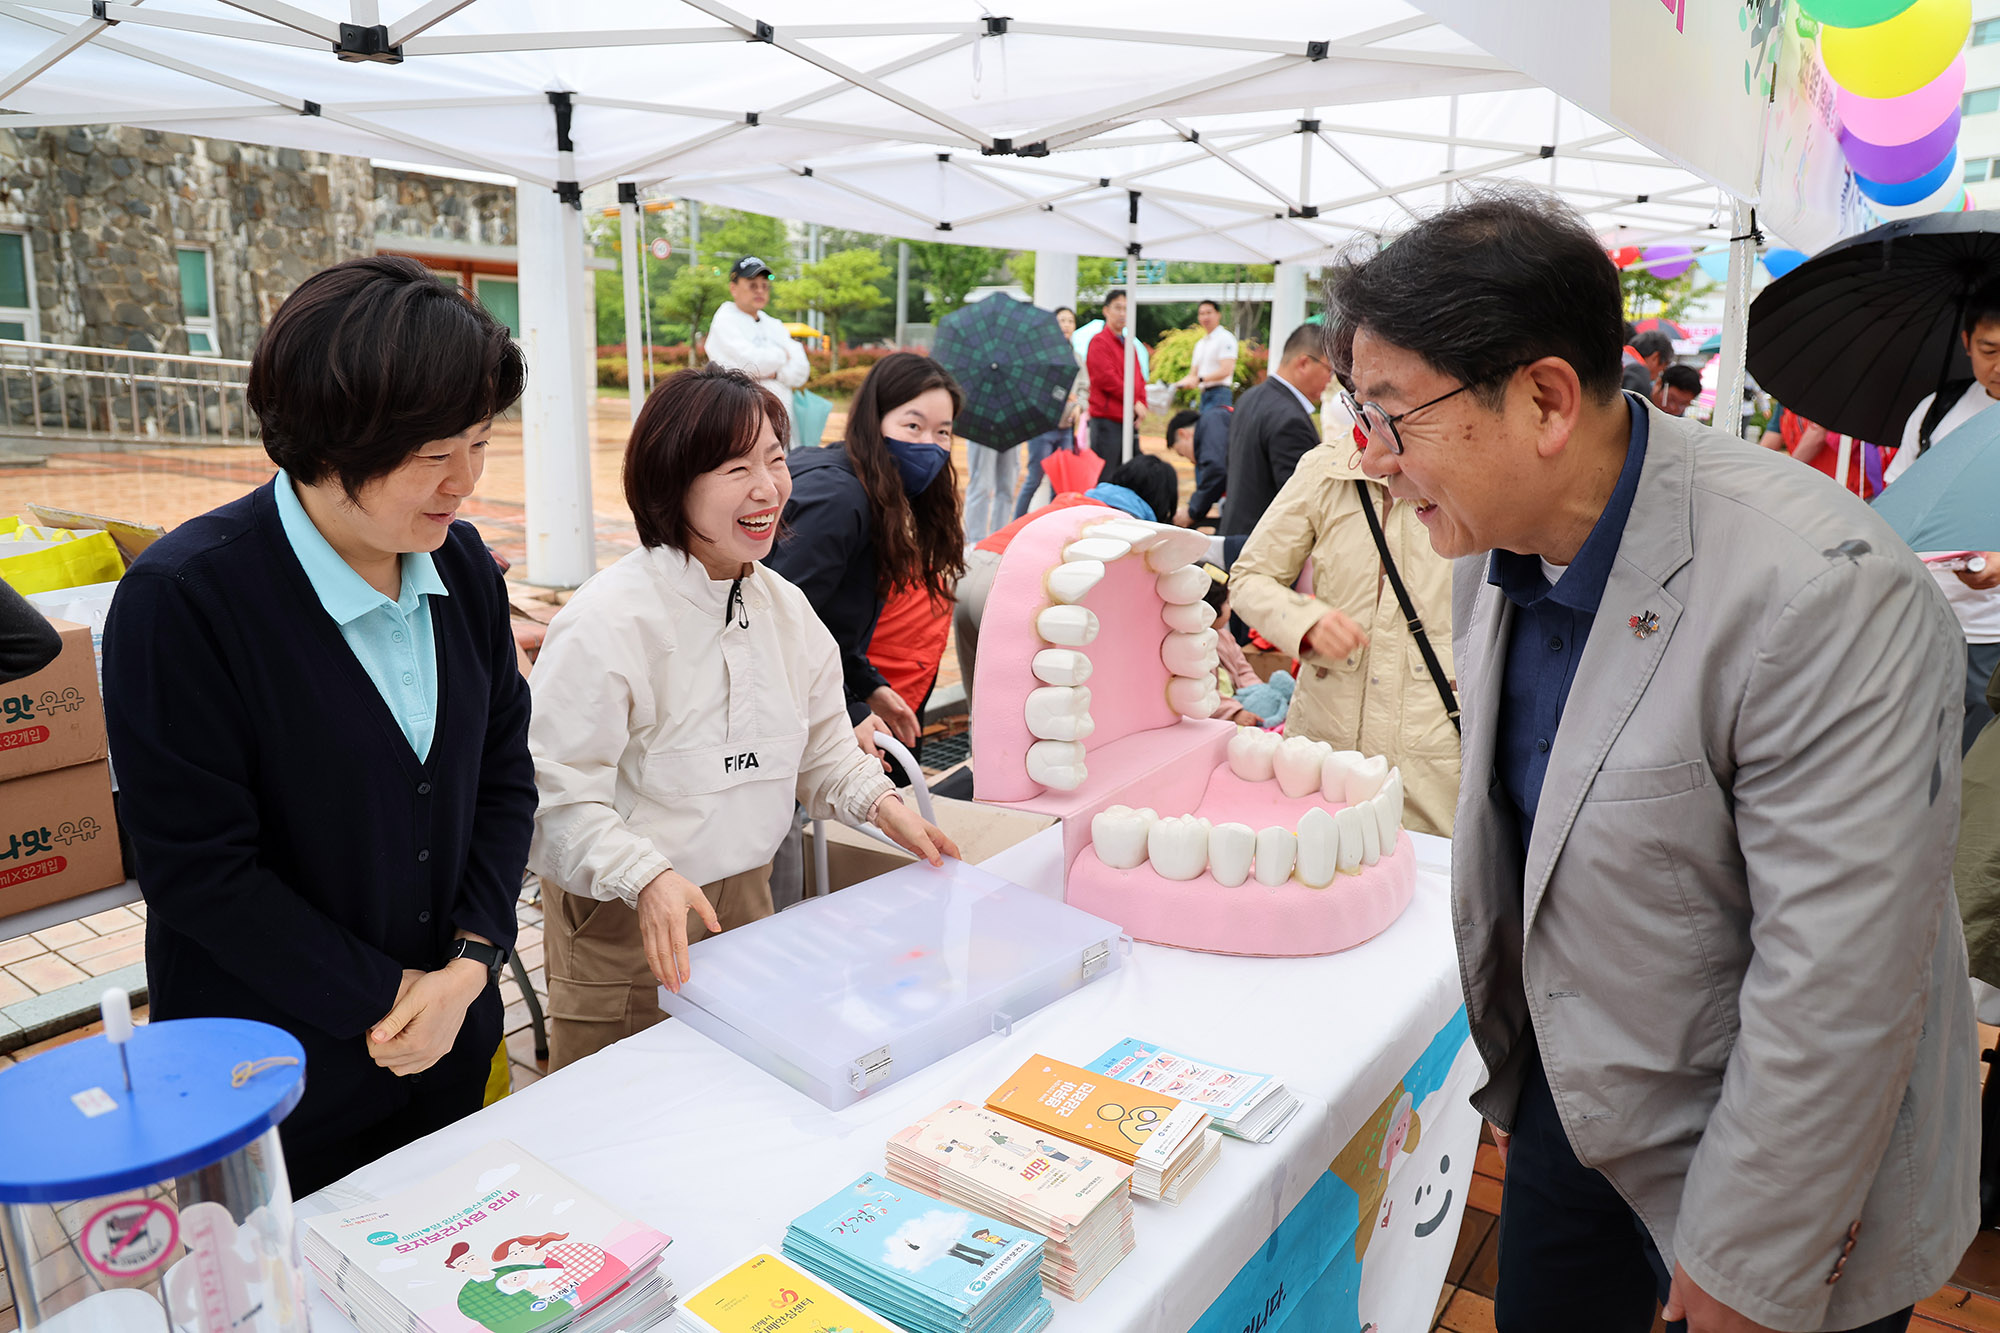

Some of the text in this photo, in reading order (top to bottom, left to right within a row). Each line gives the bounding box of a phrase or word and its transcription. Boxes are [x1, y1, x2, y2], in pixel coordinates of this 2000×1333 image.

[0, 694, 35, 724] 맛
[724, 752, 760, 774] FIFA
[1044, 1081, 1078, 1108] 영유아
[1055, 1082, 1097, 1118] 건강검진
[1019, 1158, 1051, 1181] 비만
[394, 1189, 520, 1254] 모자보건사업 안내
[369, 1233, 396, 1244] 2023
[750, 1314, 775, 1333] 김해시
